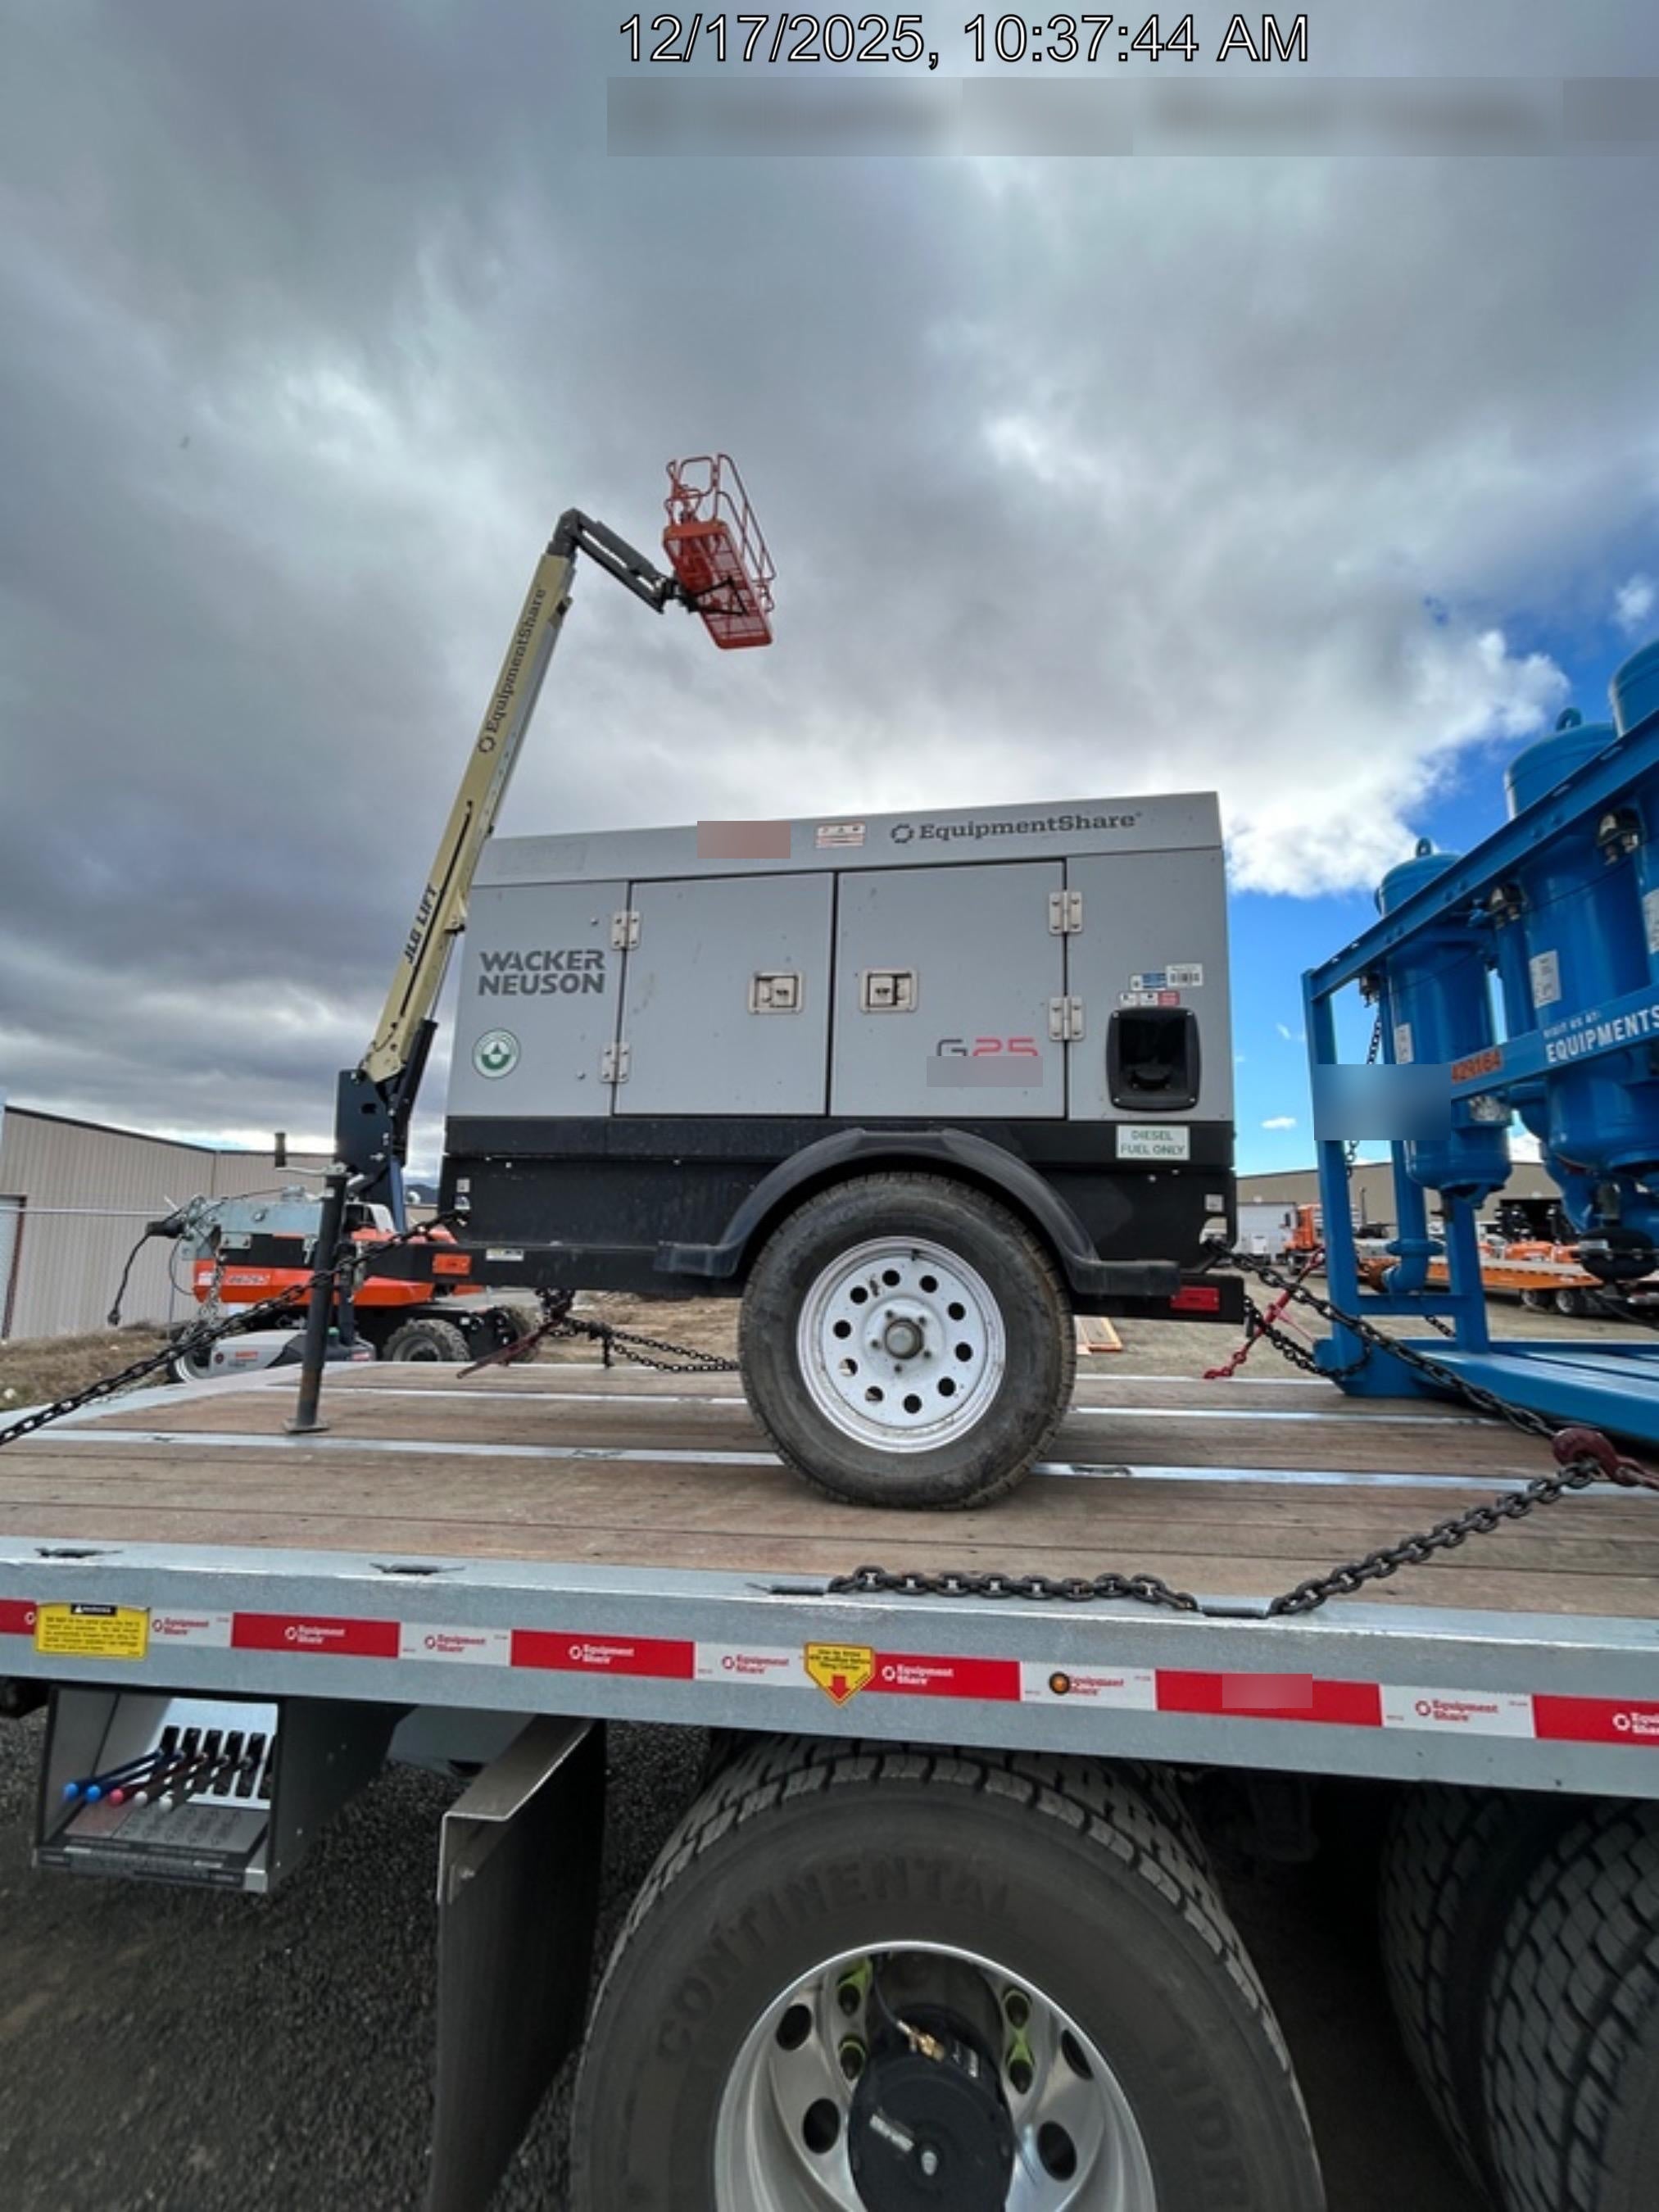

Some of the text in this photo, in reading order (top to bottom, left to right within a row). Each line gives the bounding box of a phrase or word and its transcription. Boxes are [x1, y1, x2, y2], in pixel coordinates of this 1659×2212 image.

[485, 589, 546, 733] EquipmentShare
[919, 814, 1136, 841] EquipmentShare
[404, 883, 437, 964] JLG LIFT
[479, 950, 605, 972] WACKER
[478, 972, 605, 996] NEUSON
[1131, 1130, 1174, 1141] DIESEL
[1120, 1143, 1186, 1156] FUEL ONLY
[164, 1617, 209, 1628] Equipment
[298, 1625, 345, 1637] Equipment
[437, 1634, 485, 1646] Equipment
[582, 1644, 634, 1657] Equipment
[737, 1655, 789, 1666] Equipment
[896, 1665, 954, 1677] Equipment
[1434, 1700, 1498, 1714] Equipment
[657, 1854, 1018, 2063] CONTINENTAL
